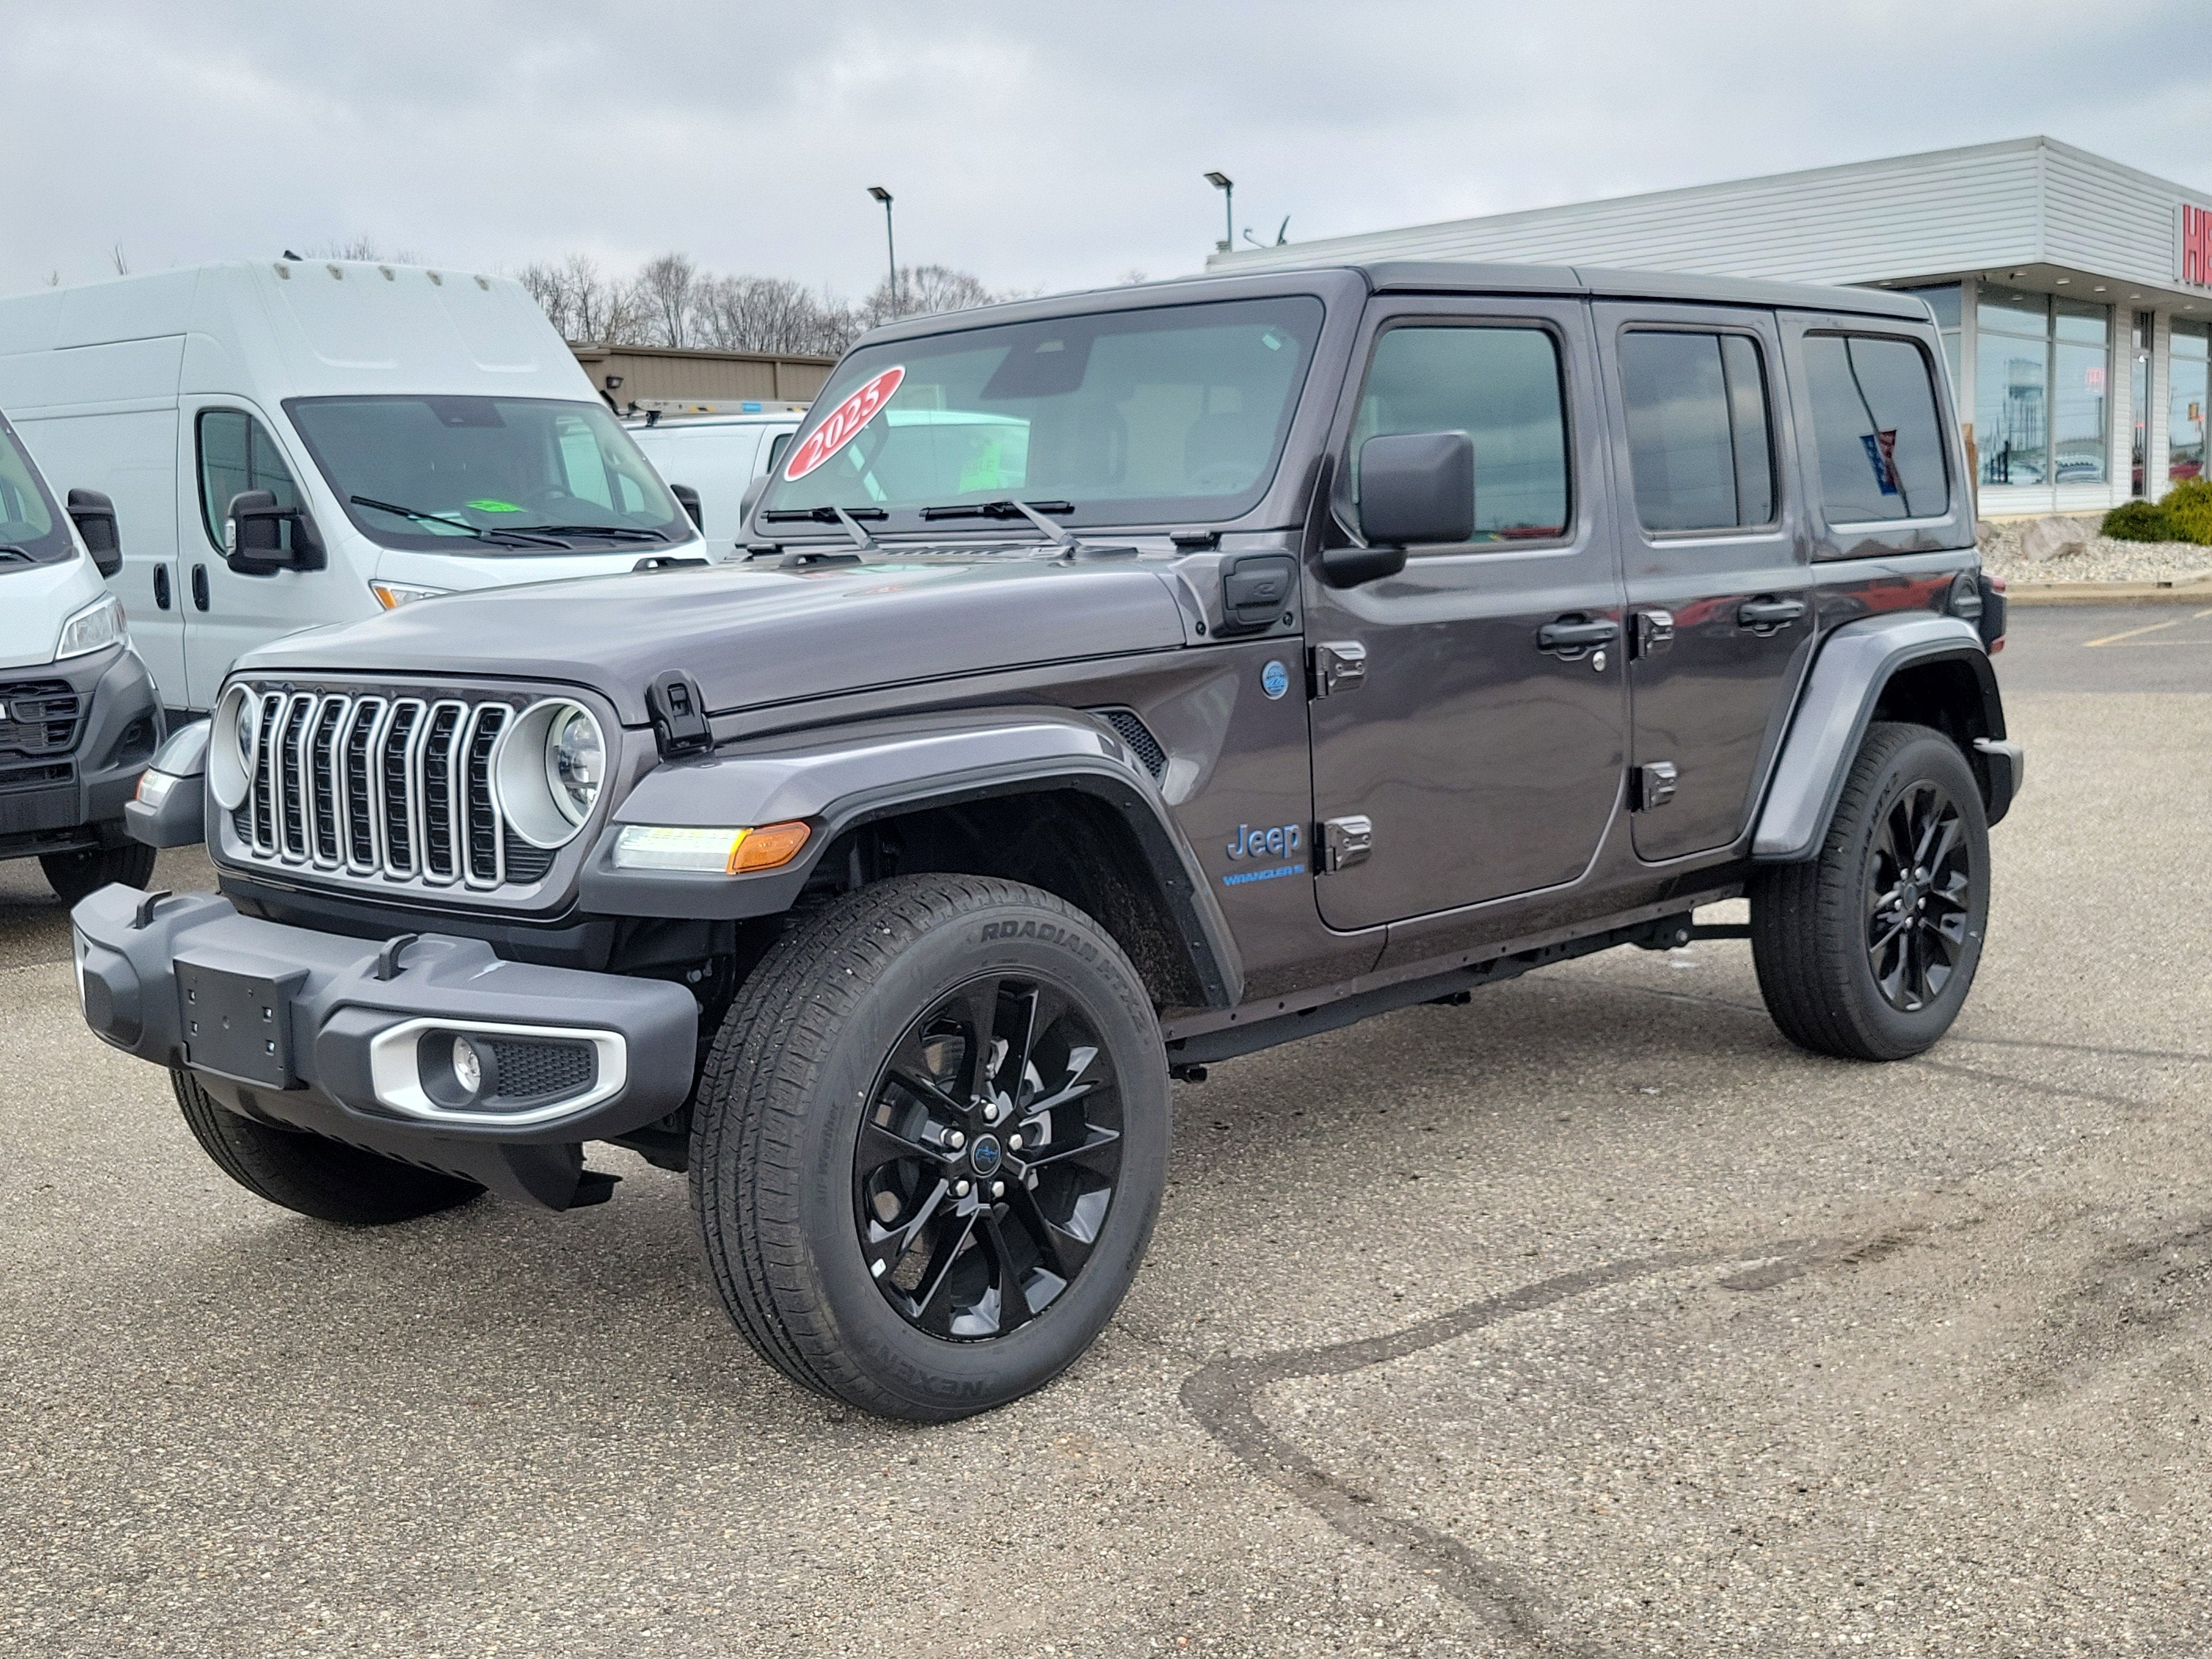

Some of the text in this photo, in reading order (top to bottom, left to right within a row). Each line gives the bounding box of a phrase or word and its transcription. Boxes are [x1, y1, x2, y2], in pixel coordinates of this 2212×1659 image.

[805, 379, 882, 471] 2025
[1227, 823, 1302, 861] Jeep
[981, 921, 1098, 962] ROADIAN
